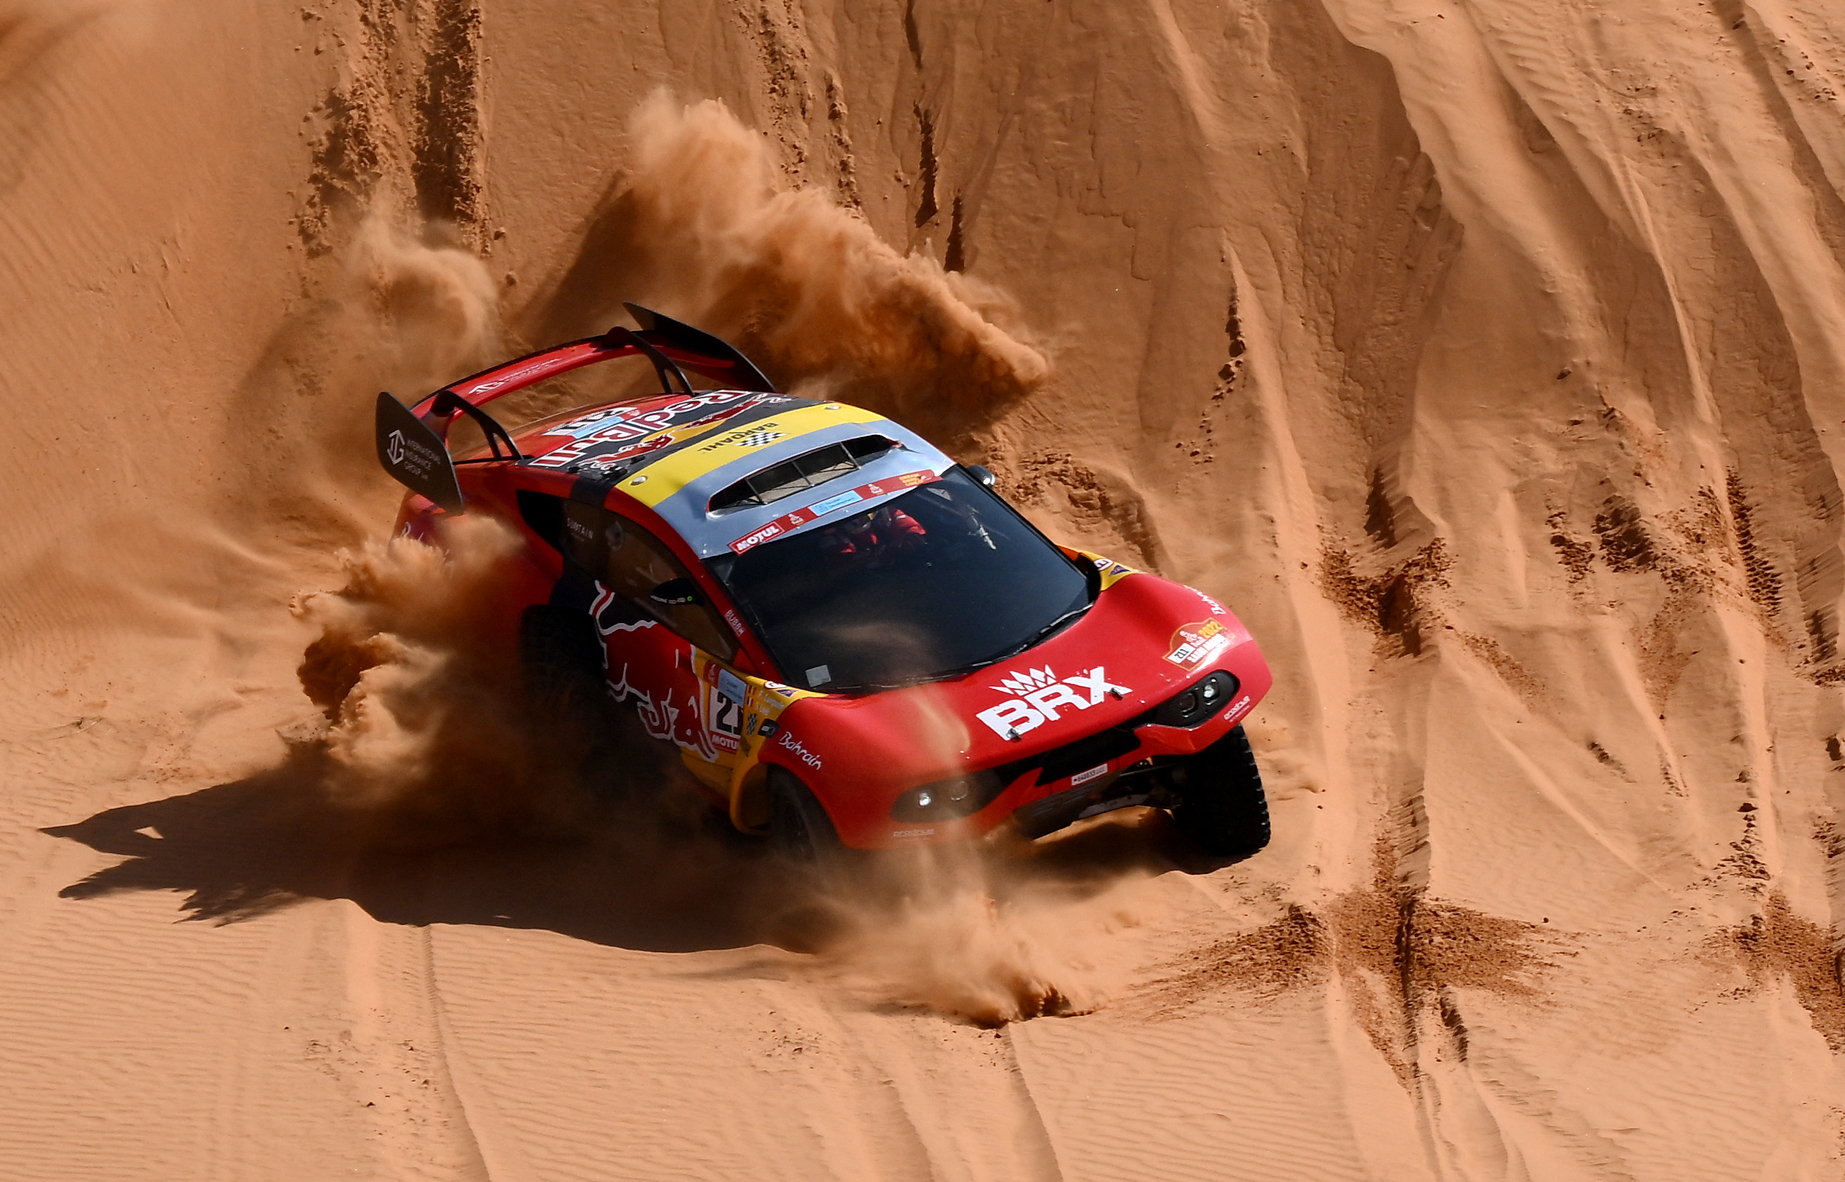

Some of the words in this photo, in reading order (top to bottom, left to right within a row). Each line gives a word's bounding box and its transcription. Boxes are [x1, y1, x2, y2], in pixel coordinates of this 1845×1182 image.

[627, 390, 753, 431] Red
[528, 424, 650, 467] Bull
[698, 422, 779, 452] BARDAHL
[736, 525, 779, 551] MOTUL
[1198, 620, 1223, 639] 2022
[1174, 648, 1189, 659] 211
[716, 690, 744, 736] 21
[976, 666, 1133, 741] BRX
[711, 734, 740, 750] MOTU
[778, 731, 822, 770] Bahrain
